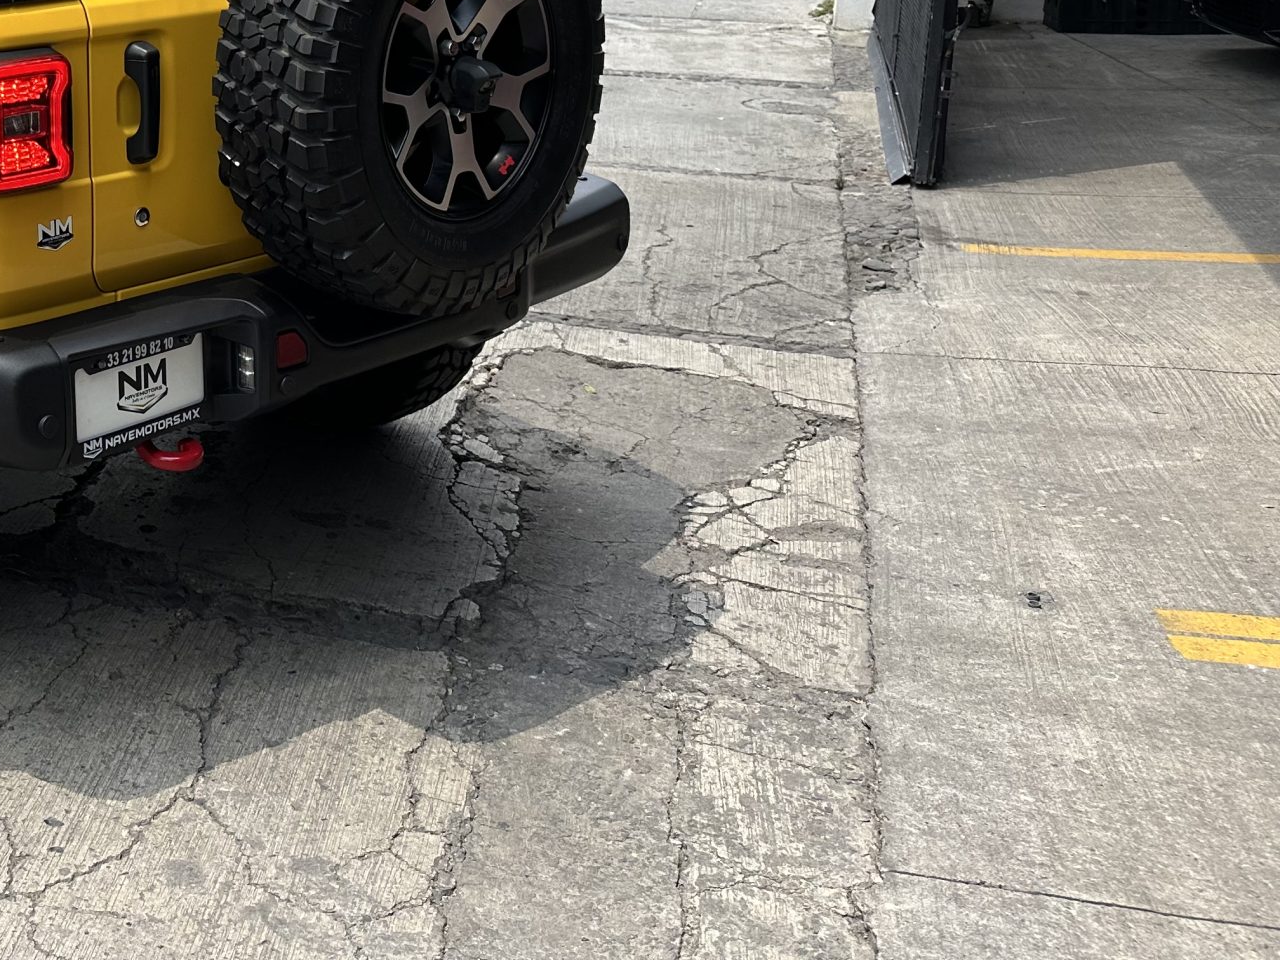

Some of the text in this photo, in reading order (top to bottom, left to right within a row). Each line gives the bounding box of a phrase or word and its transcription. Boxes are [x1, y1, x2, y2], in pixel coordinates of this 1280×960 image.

[38, 215, 73, 242] NM
[107, 336, 174, 367] 33 21 99 82 10
[118, 357, 167, 403] NM
[124, 384, 163, 401] NAVEMOTORS
[83, 407, 201, 454] NM NAVEMOTORS.MX
